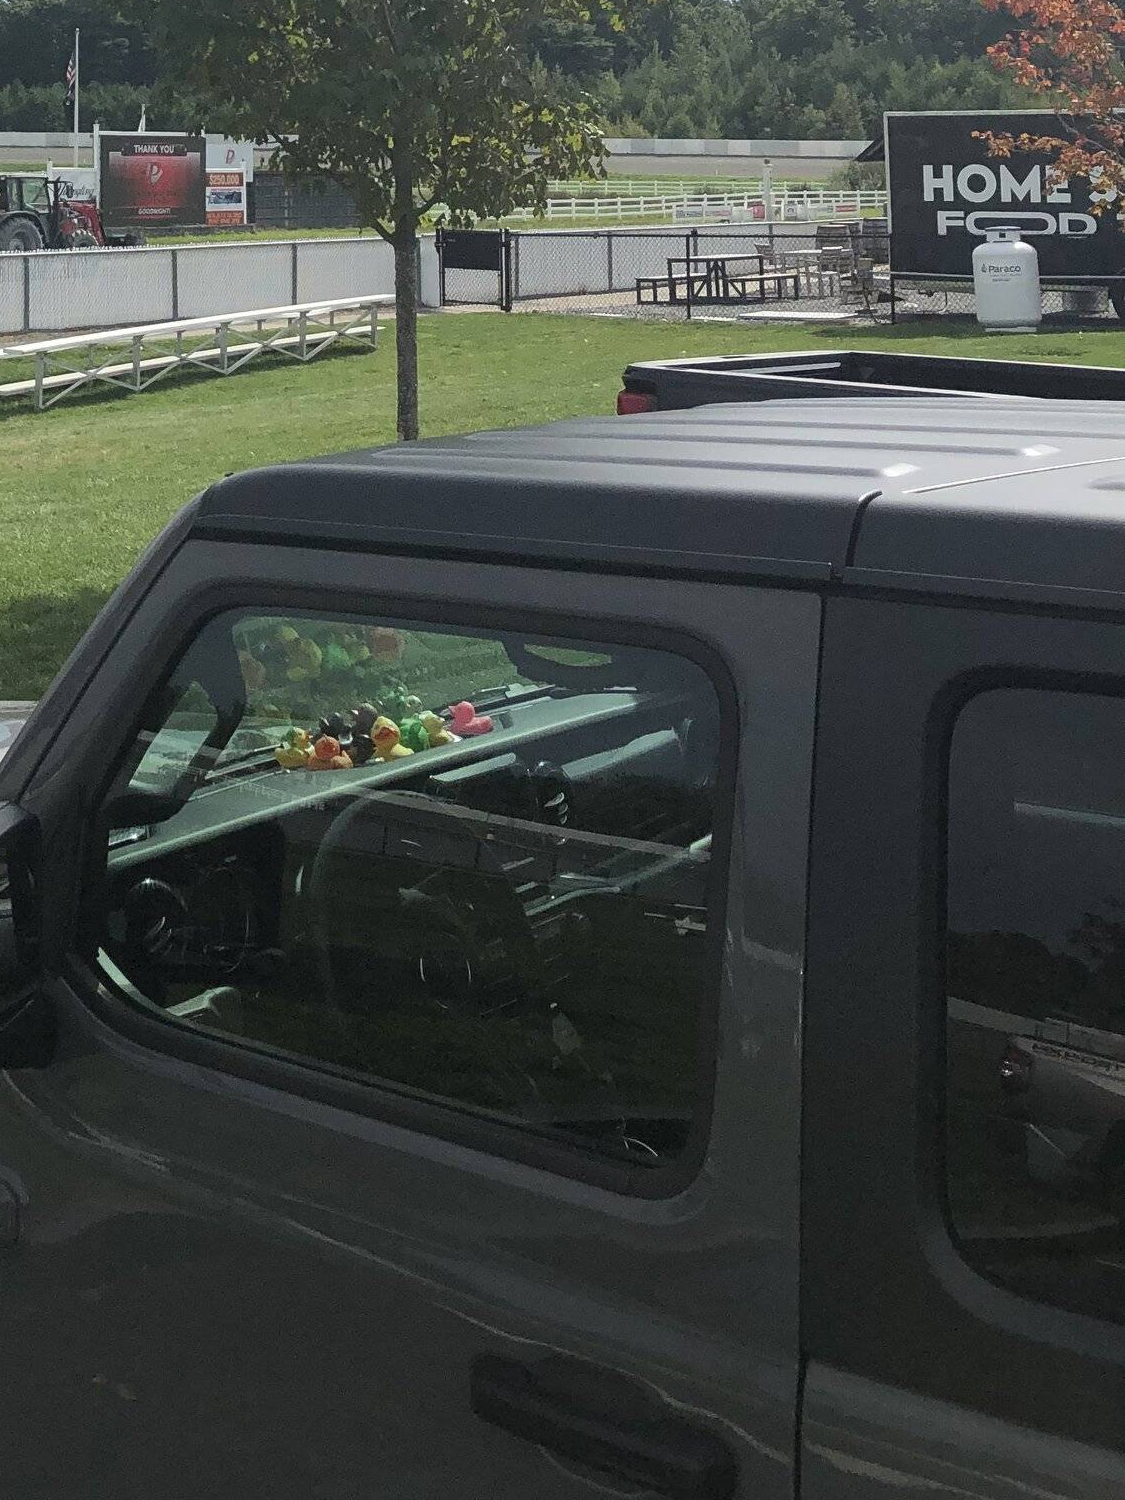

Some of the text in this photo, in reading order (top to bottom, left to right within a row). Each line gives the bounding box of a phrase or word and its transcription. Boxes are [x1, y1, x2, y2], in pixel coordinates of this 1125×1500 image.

[134, 144, 175, 153] THANK YOU
[922, 163, 1072, 204] HOME
[937, 210, 1098, 237] FOOD
[988, 265, 1021, 274] Paraco
